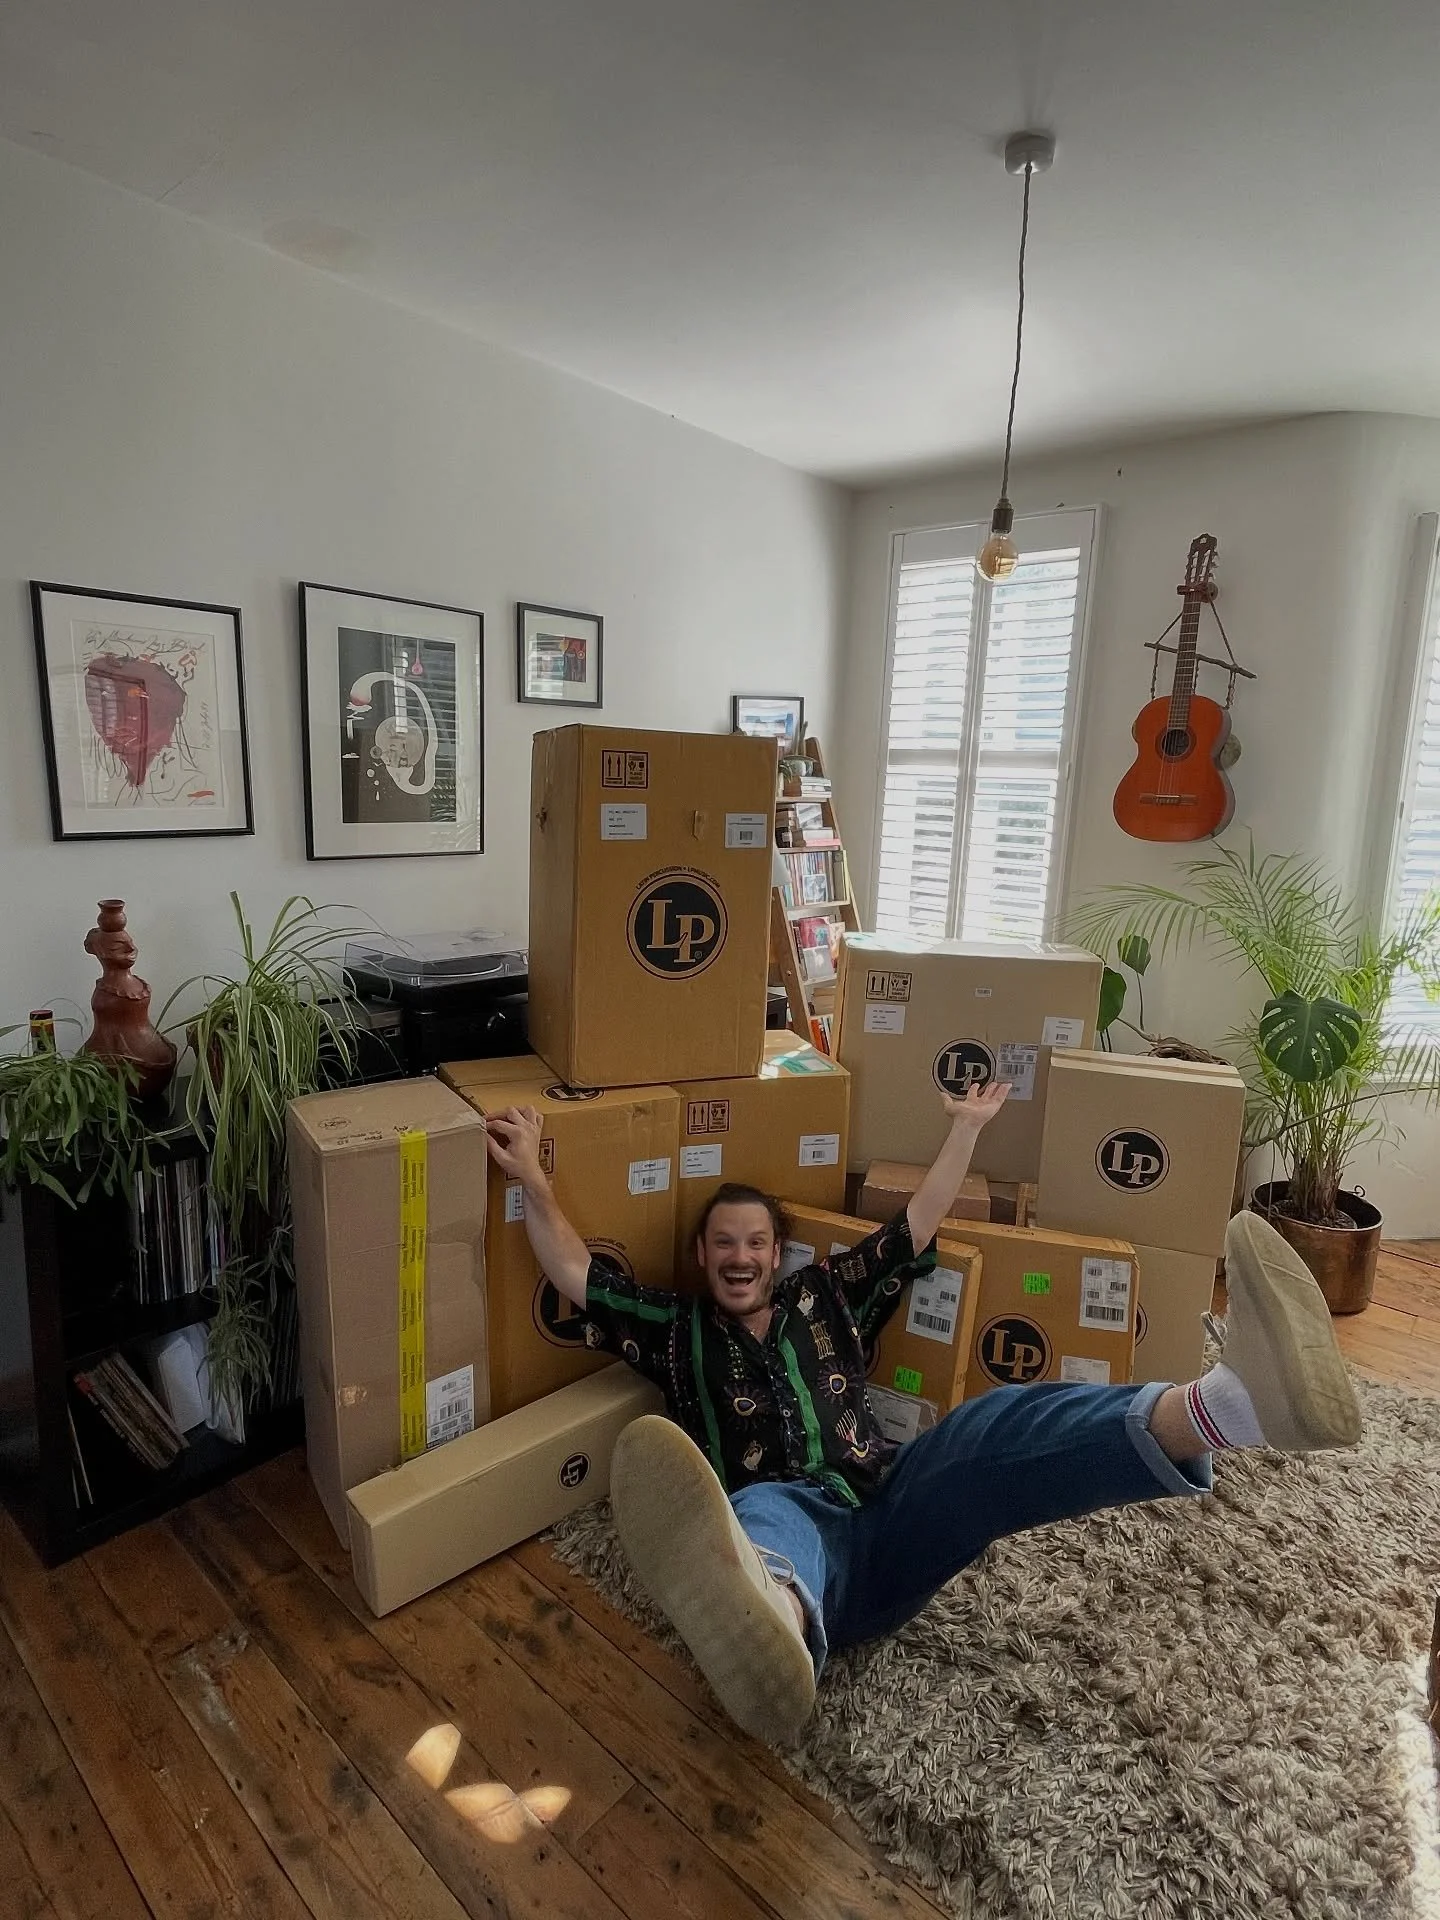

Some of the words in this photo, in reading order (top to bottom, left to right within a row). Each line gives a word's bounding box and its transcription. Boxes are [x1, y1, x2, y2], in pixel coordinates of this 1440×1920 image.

[648, 865, 682, 880] PERCUSSION
[646, 899, 715, 963] LP
[943, 1051, 988, 1091] LP
[1107, 1140, 1160, 1185] LP
[989, 1328, 1042, 1380] LP
[563, 1456, 583, 1485] LP
